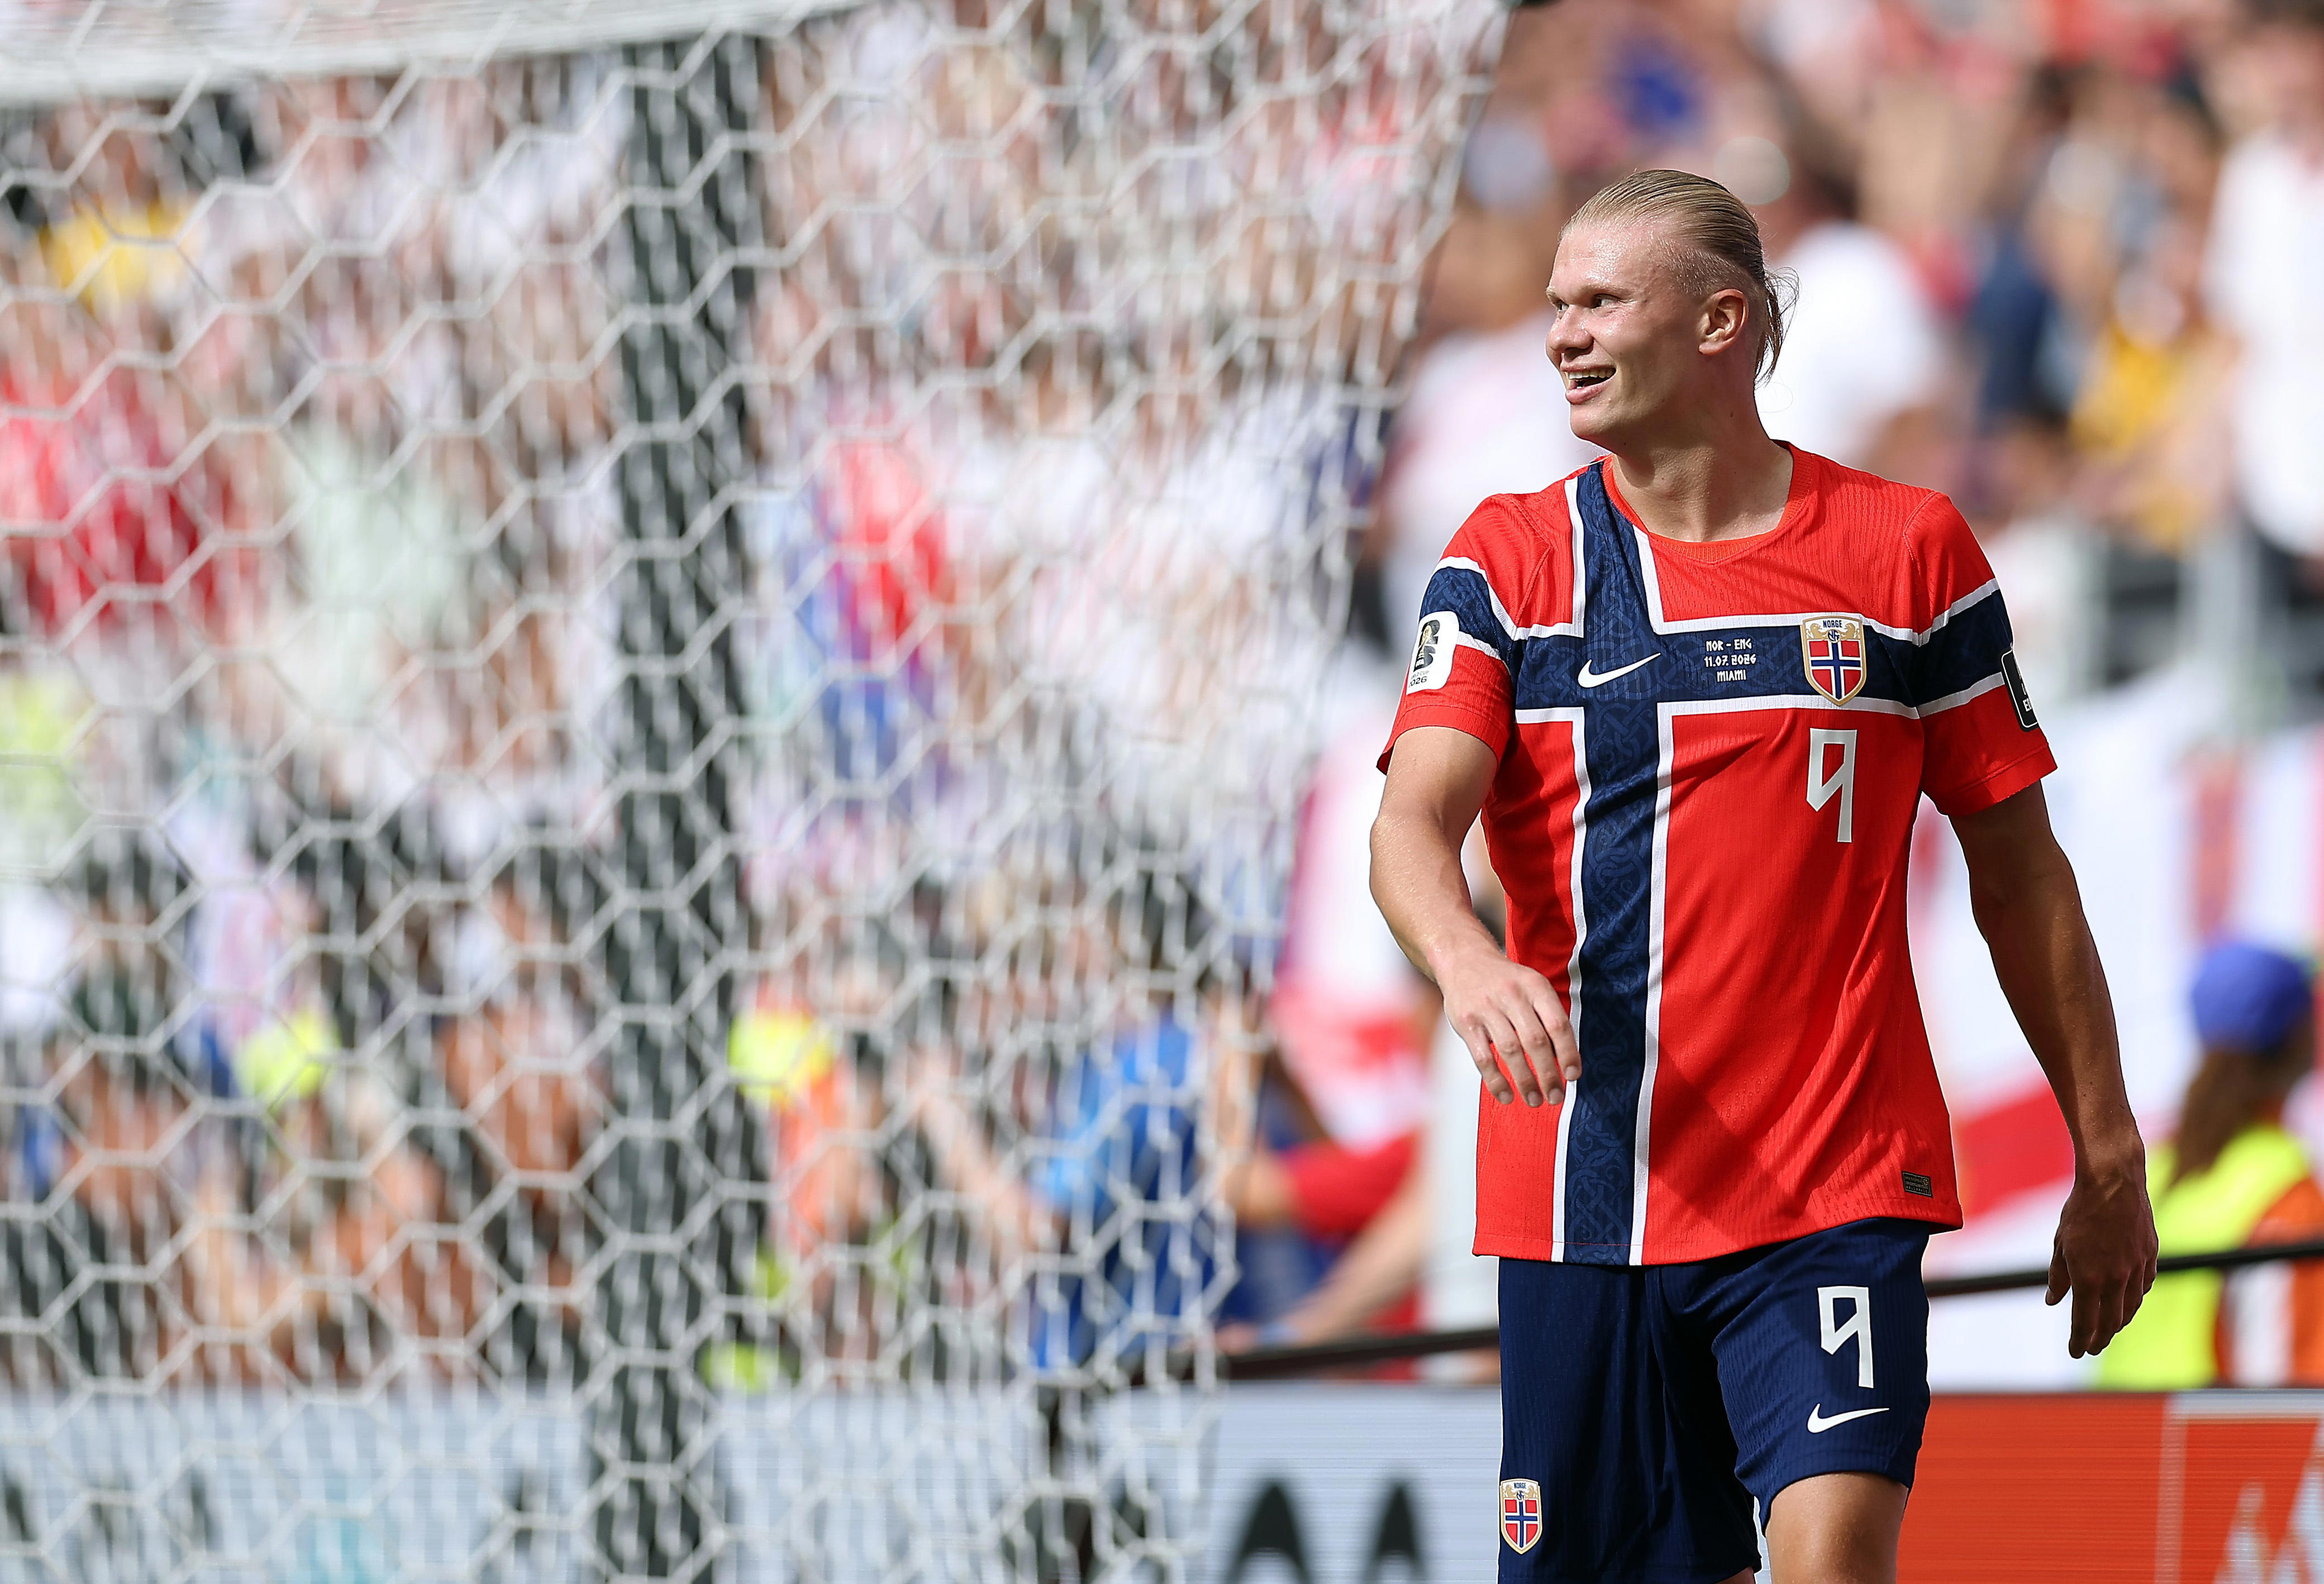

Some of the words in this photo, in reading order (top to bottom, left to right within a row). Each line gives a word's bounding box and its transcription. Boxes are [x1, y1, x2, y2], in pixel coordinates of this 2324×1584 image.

[1706, 640, 1724, 652] NOR
[1734, 638, 1752, 650] ENG
[1717, 669, 1746, 682] MIAMI
[1806, 727, 1858, 842] 9
[1817, 1286, 1874, 1389] 9
